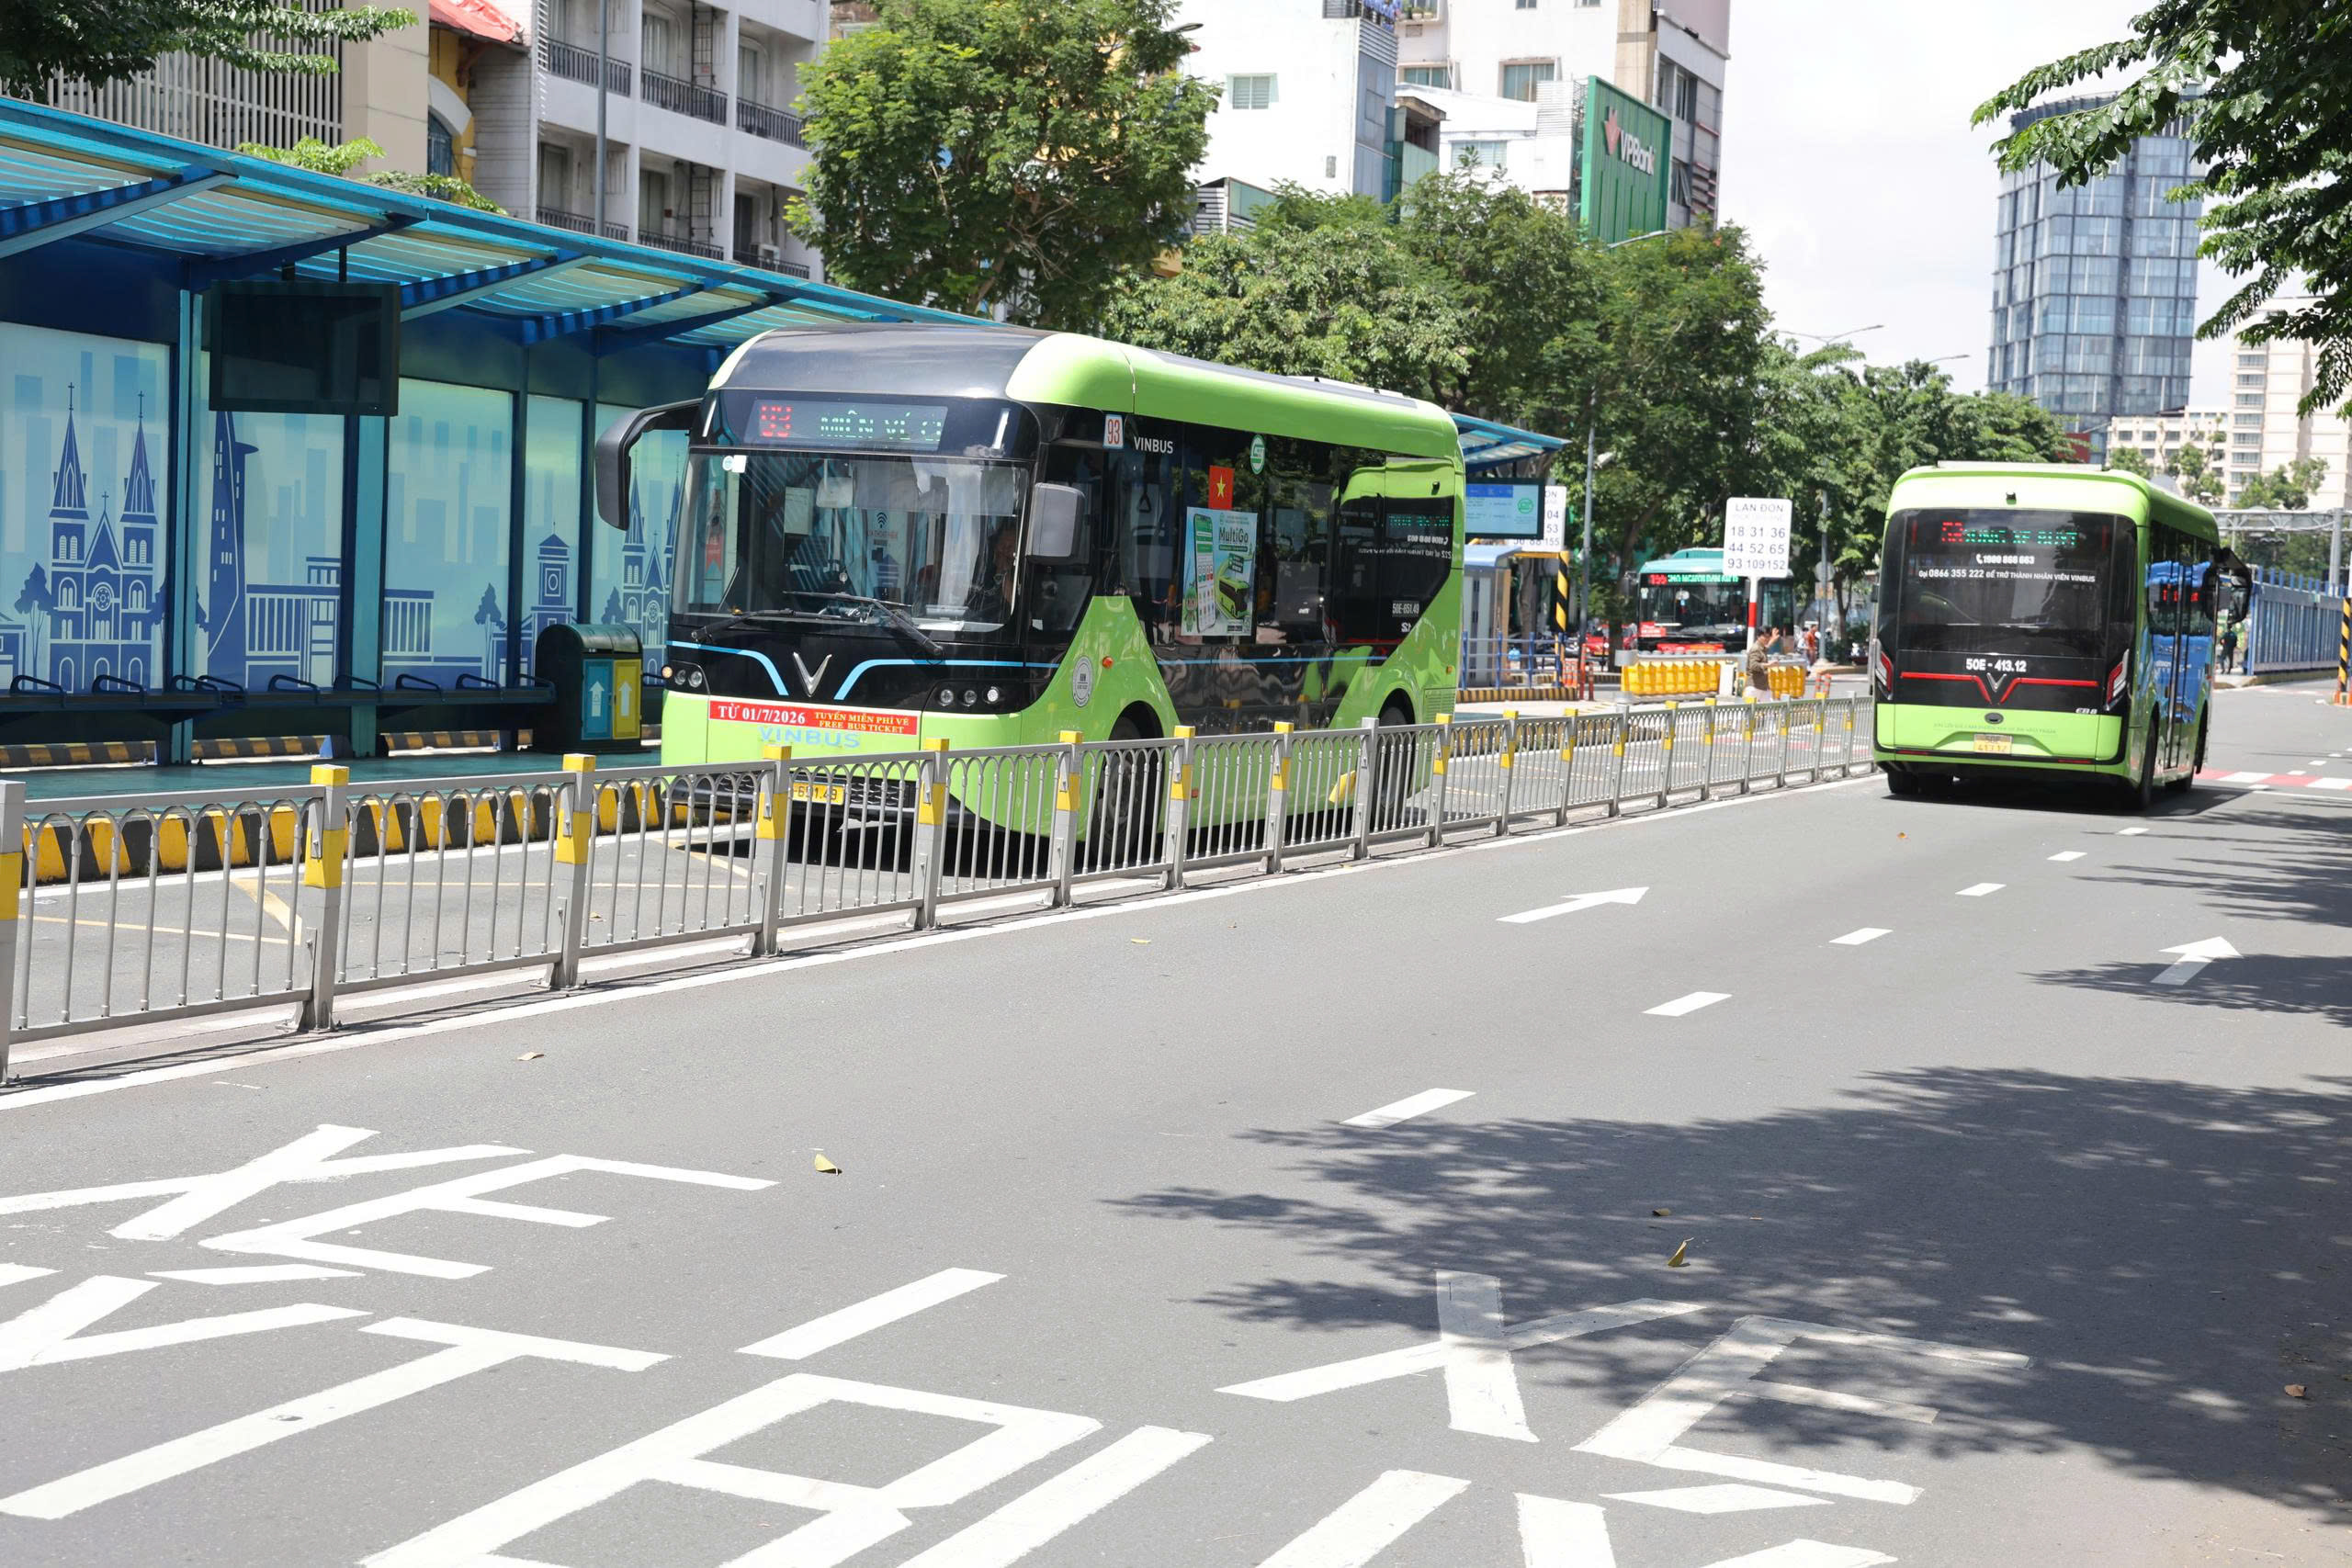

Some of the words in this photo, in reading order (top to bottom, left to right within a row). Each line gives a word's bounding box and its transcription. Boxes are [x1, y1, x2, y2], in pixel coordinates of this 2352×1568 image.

[1621, 130, 1655, 175] VPBank
[1107, 419, 1120, 444] 93
[1134, 436, 1174, 455] VINBUS
[1546, 510, 1559, 520] 04
[1219, 527, 1250, 544] MultiGo
[1546, 524, 1559, 534] 53
[1731, 526, 1745, 536] 18
[1750, 526, 1764, 537] 31
[1770, 527, 1786, 538] 36
[1728, 542, 1744, 552] 44
[1749, 543, 1764, 554] 52
[1770, 544, 1785, 555] 65
[1727, 558, 1743, 569] 93
[1747, 558, 1765, 570] 109
[1767, 559, 1786, 570] 152
[1929, 569, 1950, 578] 0866
[1951, 569, 1967, 578] 355
[1968, 569, 1984, 578] 222
[2071, 574, 2095, 582] VINBUS
[1966, 658, 1985, 671] 50E
[1995, 659, 2027, 672] 413.12
[718, 703, 741, 719] TỪ
[742, 706, 806, 725] 01/7/2026
[815, 710, 846, 721] TUYẾN
[848, 713, 874, 724] MIỄN
[896, 716, 910, 726] VÉ
[819, 720, 843, 728] FREE
[847, 722, 866, 730] BUS
[867, 724, 905, 734] TICKET
[758, 726, 860, 749] VINBUS
[1215, 1269, 2030, 1505] XE
